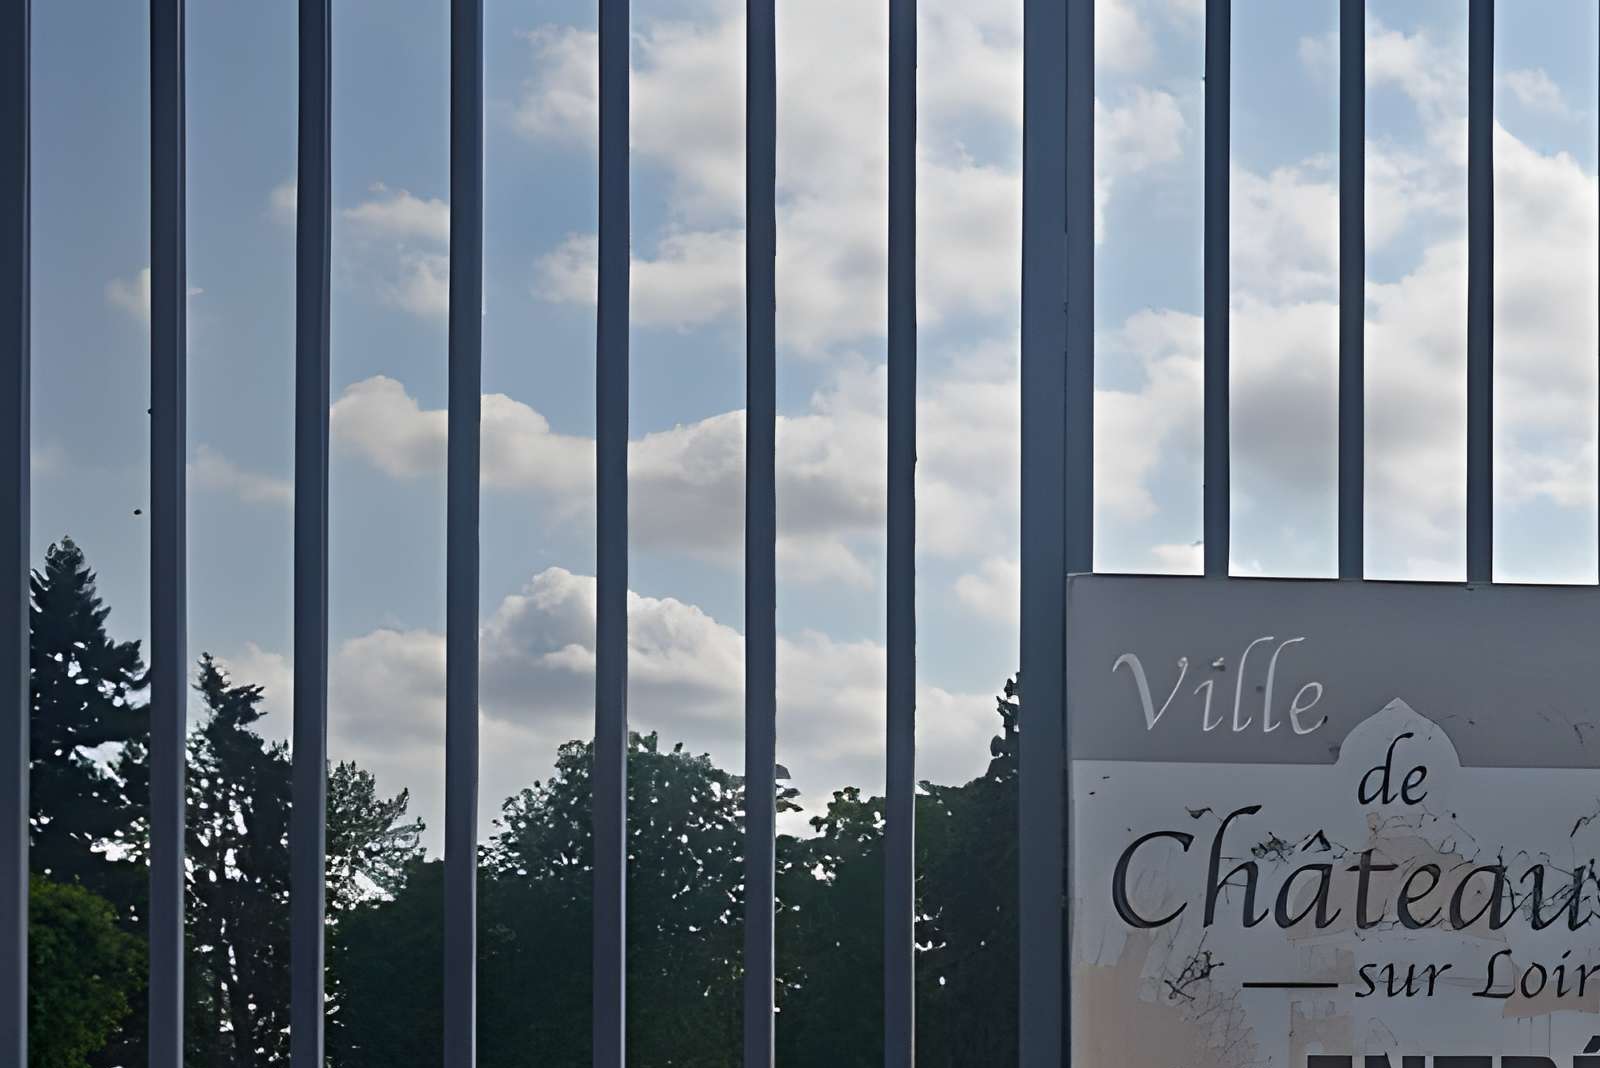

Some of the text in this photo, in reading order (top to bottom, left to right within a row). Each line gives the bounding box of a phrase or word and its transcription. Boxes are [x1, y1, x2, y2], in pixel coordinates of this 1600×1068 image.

[1111, 635, 1329, 735] Ville
[1357, 731, 1429, 806] de
[1354, 962, 1453, 998] sur
